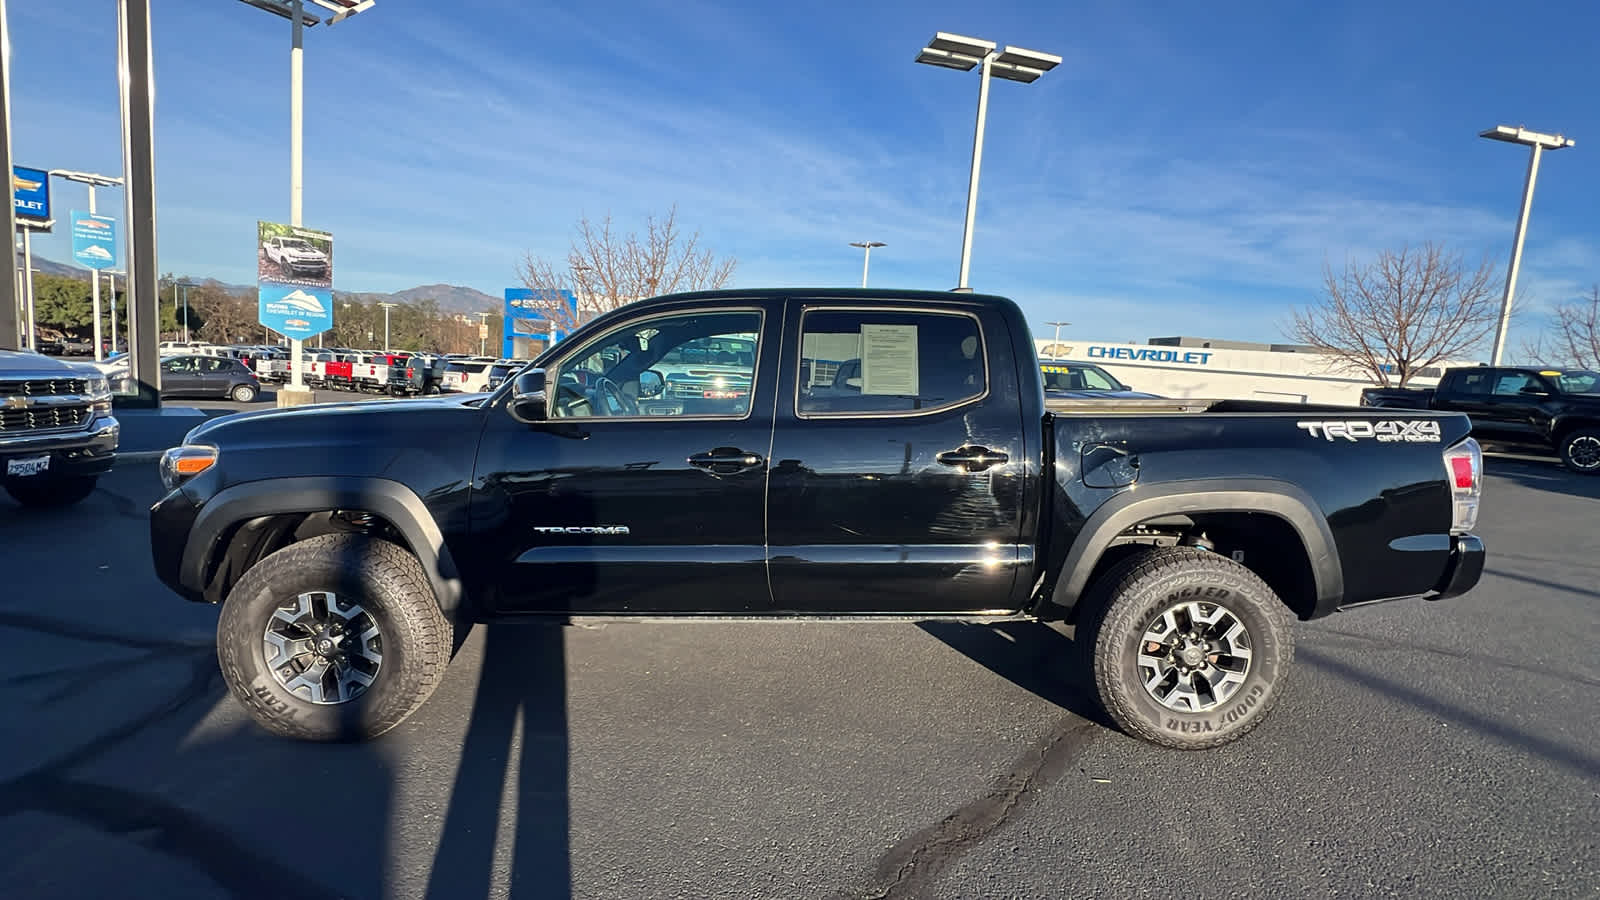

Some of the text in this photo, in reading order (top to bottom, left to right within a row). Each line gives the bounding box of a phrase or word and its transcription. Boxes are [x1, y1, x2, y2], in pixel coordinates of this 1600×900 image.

[1087, 346, 1213, 365] CHEVROLET
[1297, 420, 1376, 442] TRD
[1376, 434, 1441, 442] OFF ROAD
[533, 526, 630, 535] TACOMA
[1133, 586, 1231, 632] WRANGLER
[254, 685, 299, 720] YEAR
